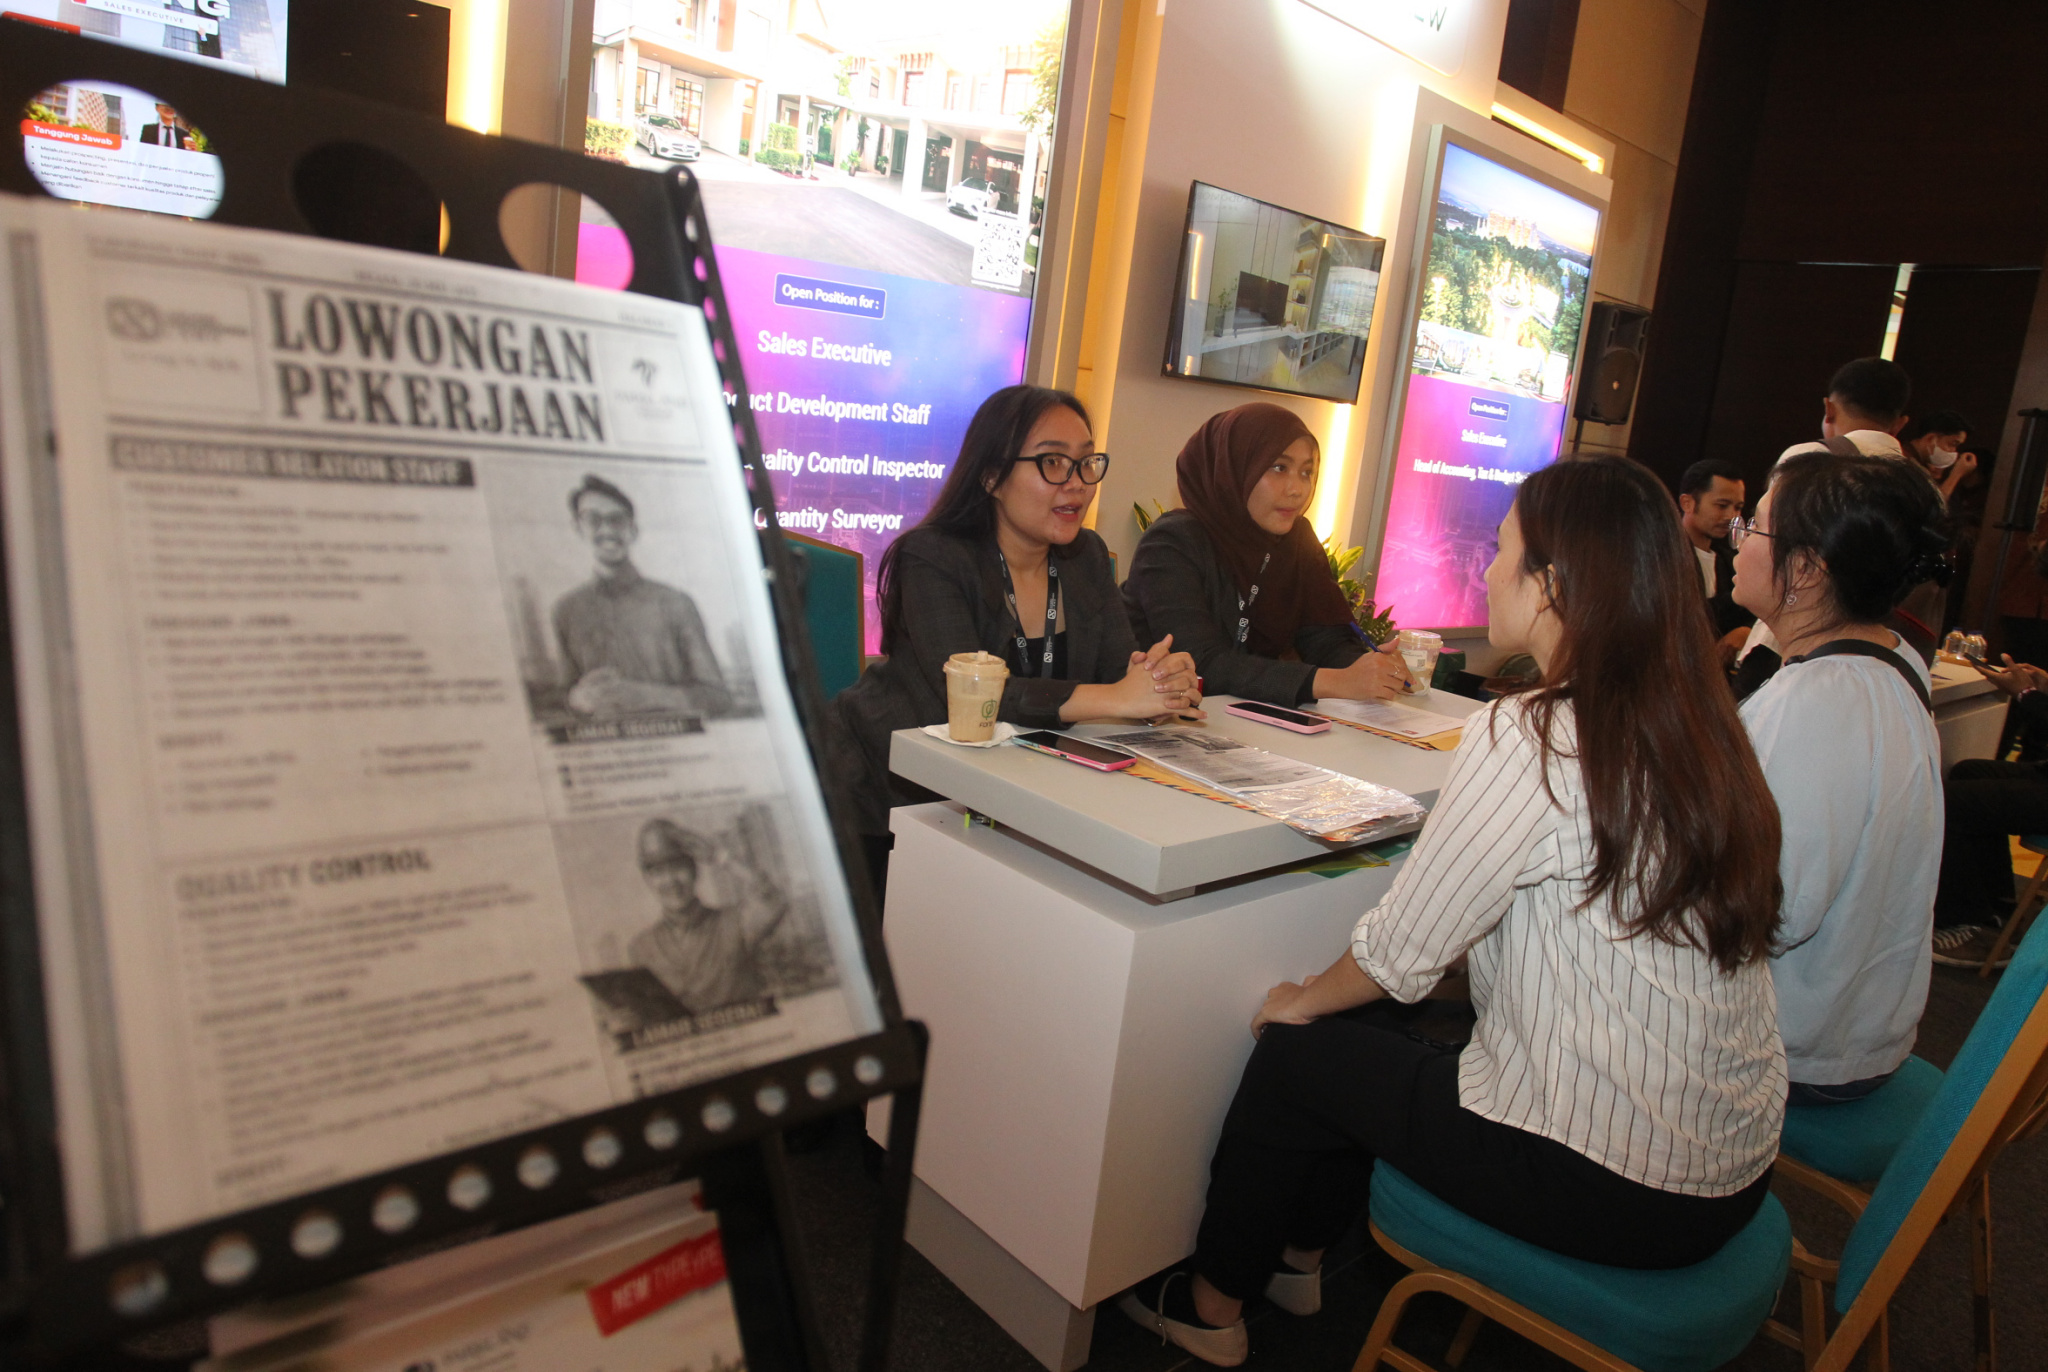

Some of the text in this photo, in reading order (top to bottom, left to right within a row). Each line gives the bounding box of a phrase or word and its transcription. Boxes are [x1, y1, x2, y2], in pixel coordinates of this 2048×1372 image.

[104, 1, 184, 23] SALES EXECUTIVE
[33, 125, 113, 146] Tanggung Jawab
[782, 283, 813, 301] Open
[815, 287, 858, 306] Position
[265, 287, 596, 386] LOWONGAN
[757, 330, 892, 366] Sales Executive
[276, 359, 606, 443] PEKERJAAN
[777, 391, 887, 423] Development
[891, 402, 931, 426] Staff
[807, 452, 868, 477] Control
[872, 453, 945, 482] Inspector
[754, 506, 903, 535] Qantity Surveyor
[175, 847, 434, 899] QUALITY CONTROL
